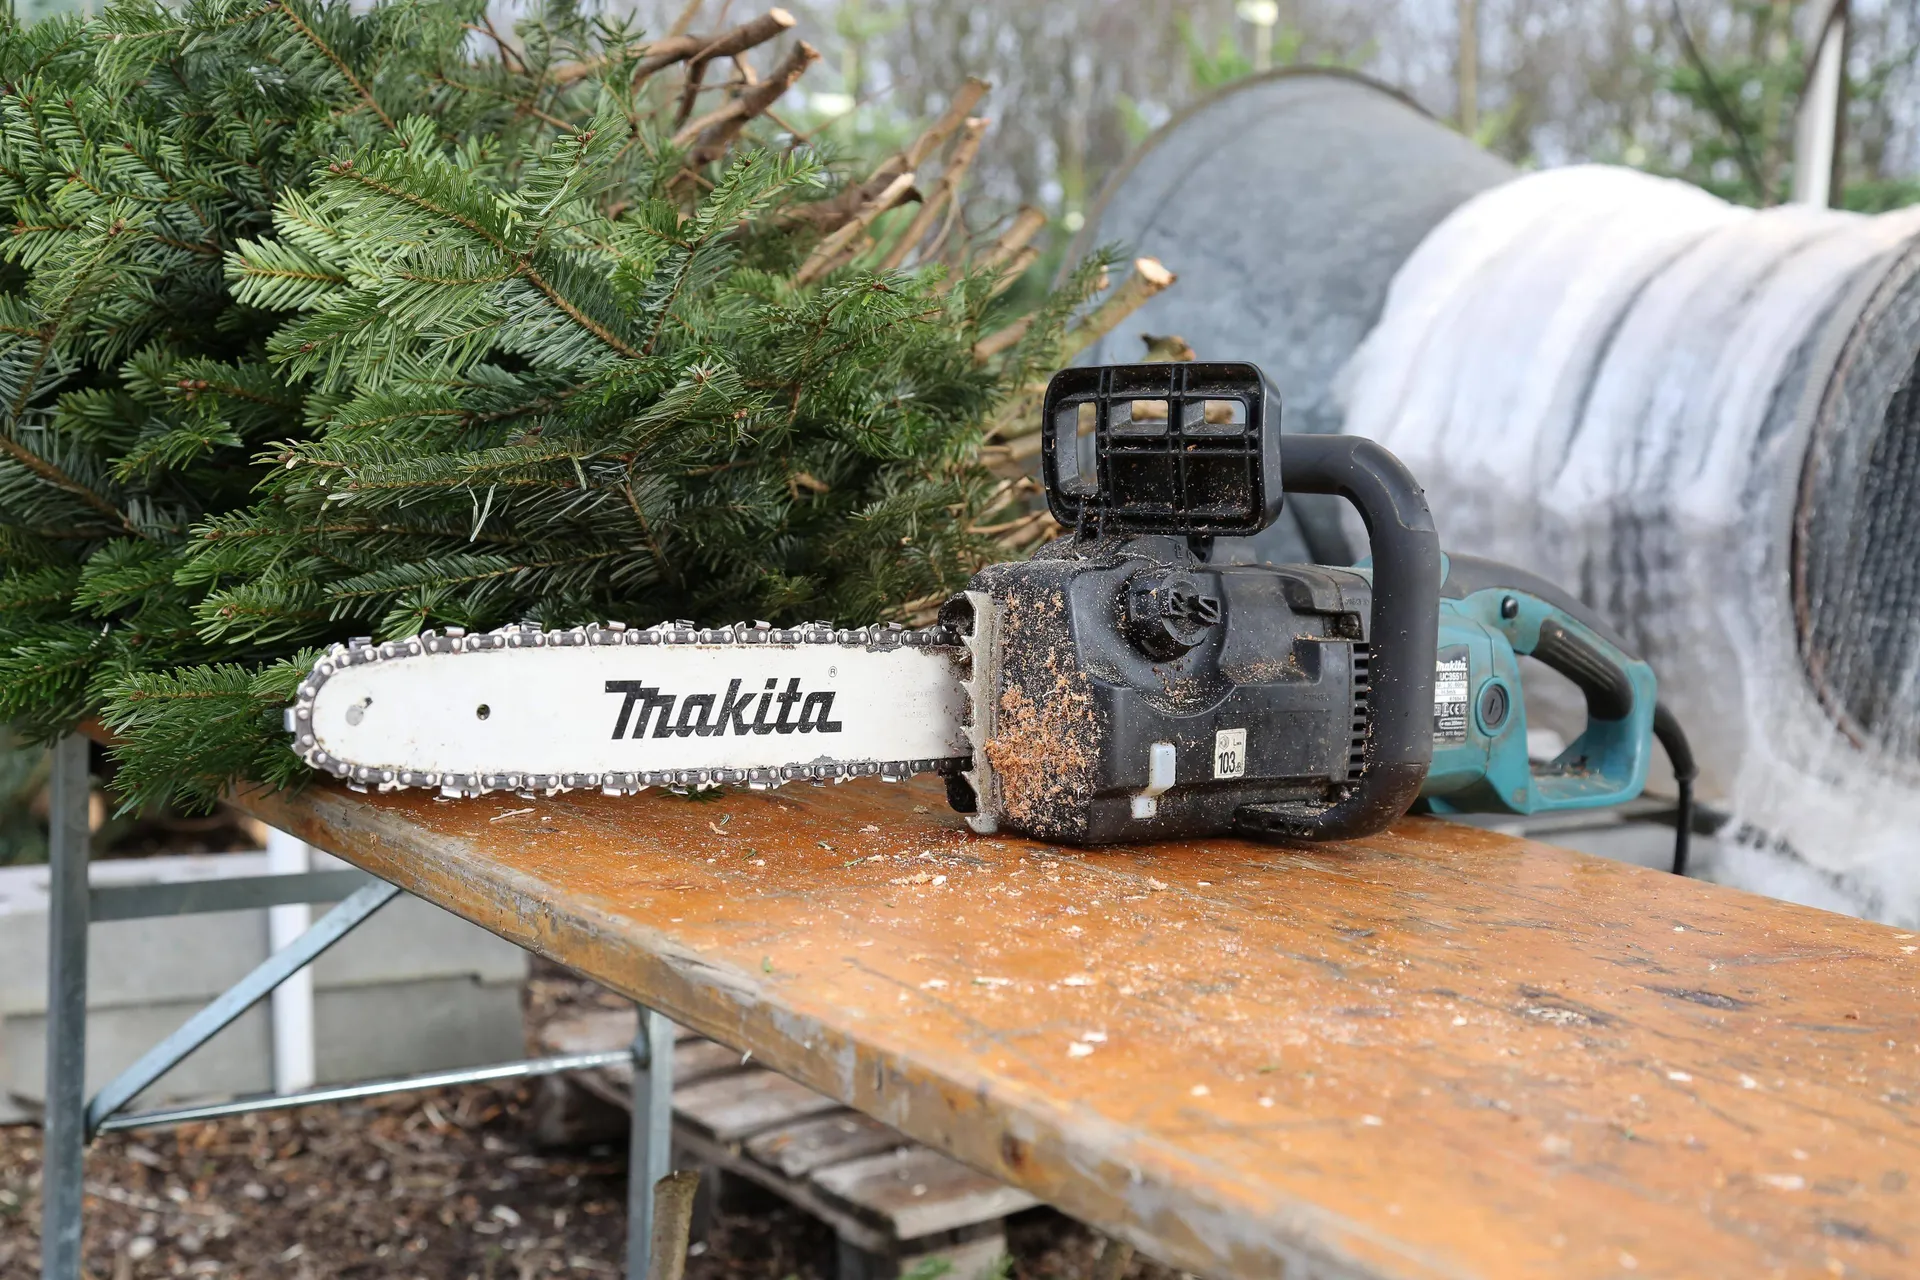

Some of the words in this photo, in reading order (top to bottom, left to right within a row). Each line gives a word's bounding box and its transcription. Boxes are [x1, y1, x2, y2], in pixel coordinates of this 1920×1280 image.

[1436, 660, 1468, 672] Makita
[605, 677, 842, 740] Makita
[1219, 751, 1236, 774] 103
